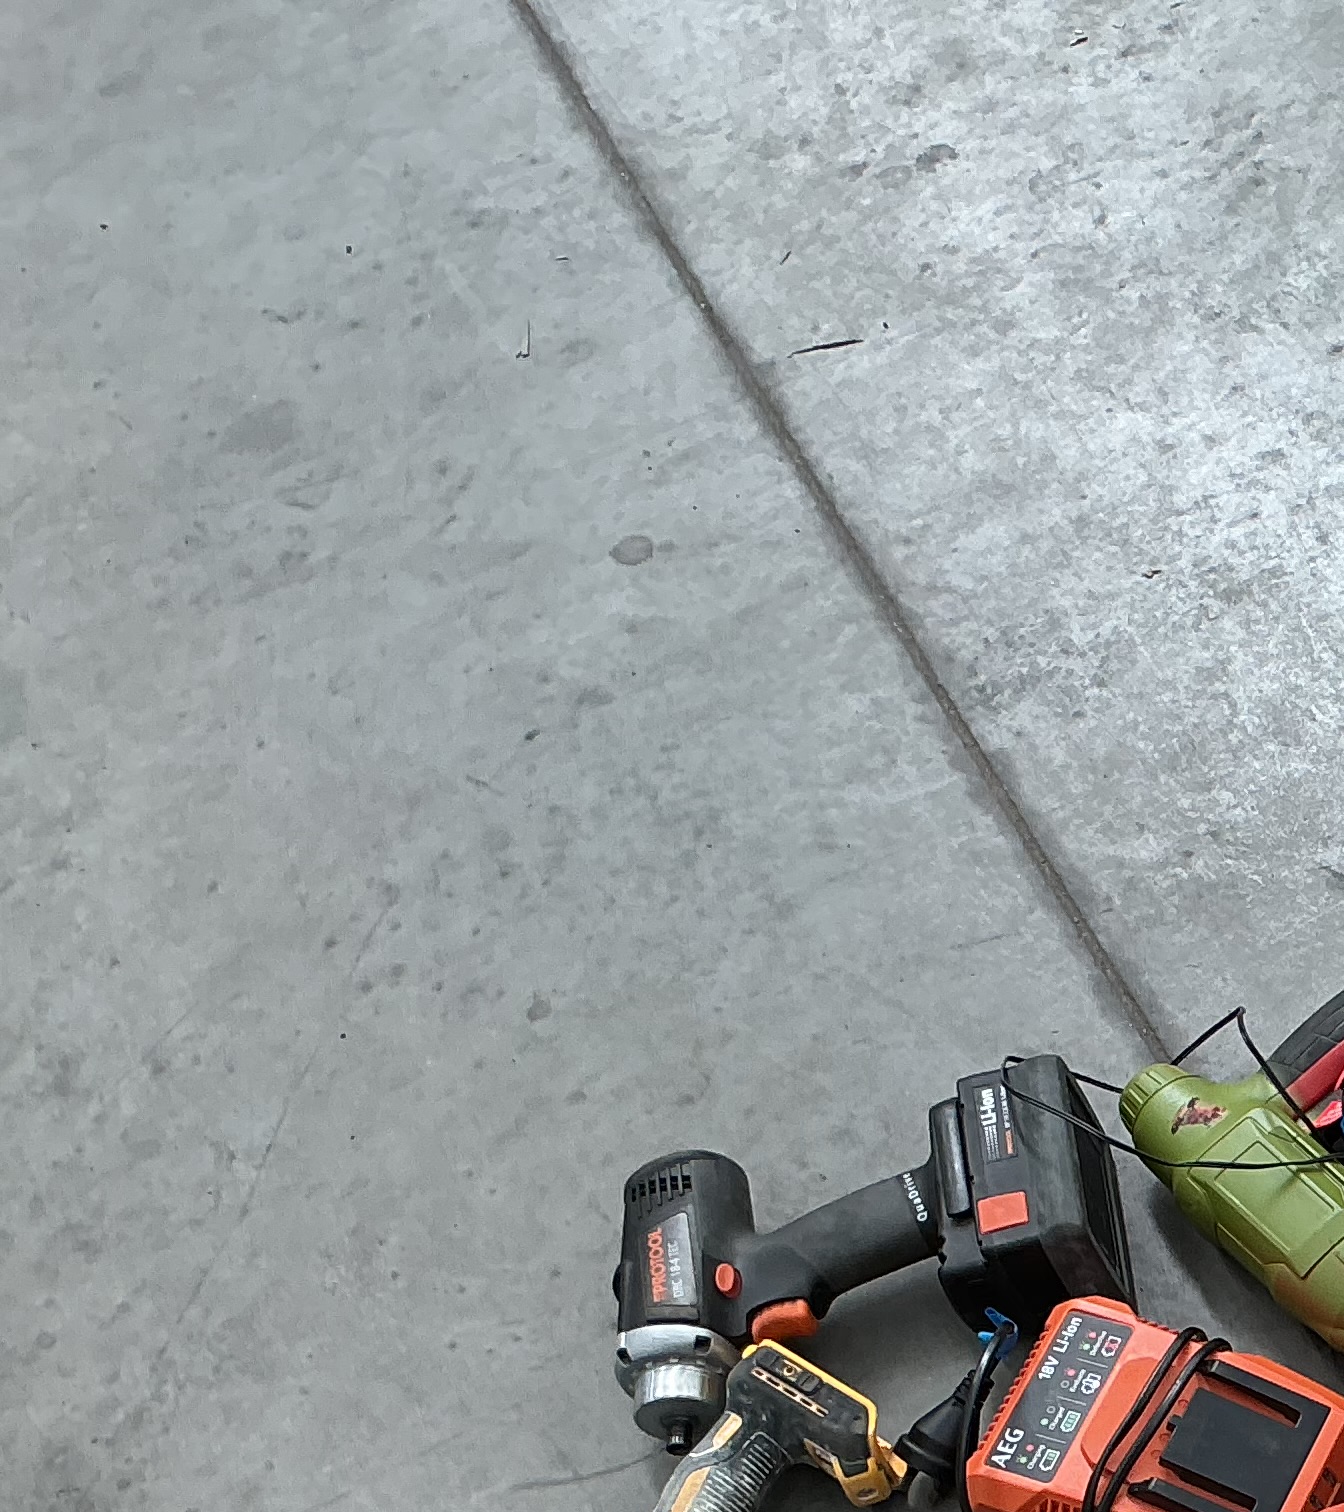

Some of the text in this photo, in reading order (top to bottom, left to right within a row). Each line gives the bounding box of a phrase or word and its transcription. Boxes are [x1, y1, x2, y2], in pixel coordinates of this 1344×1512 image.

[902, 1171, 928, 1223] QuaDrive
[647, 1227, 664, 1291] PROTOOL
[1036, 1313, 1083, 1383] 18V Li-Ion
[989, 1424, 1025, 1469] AEG
[1026, 1442, 1047, 1470] Charging
